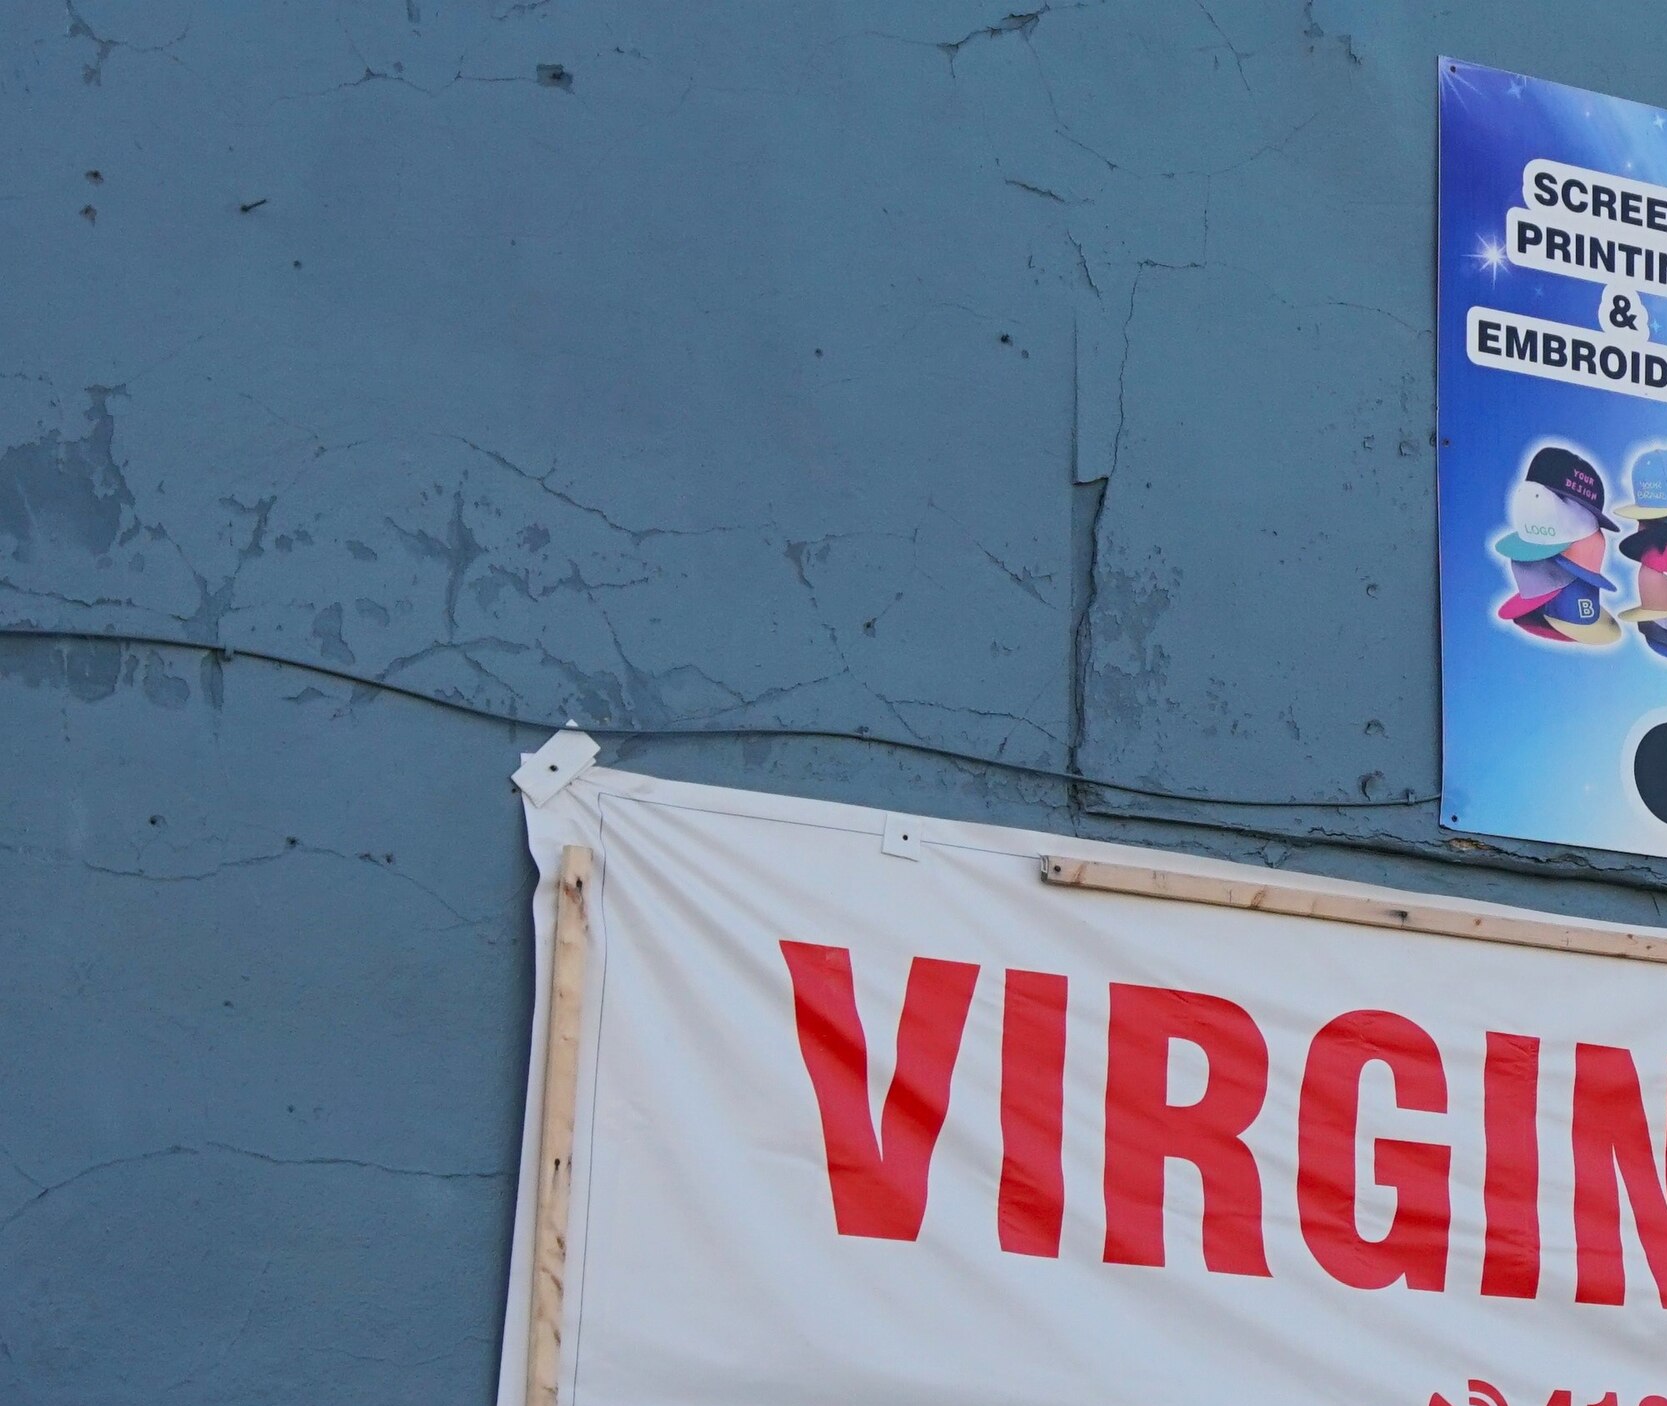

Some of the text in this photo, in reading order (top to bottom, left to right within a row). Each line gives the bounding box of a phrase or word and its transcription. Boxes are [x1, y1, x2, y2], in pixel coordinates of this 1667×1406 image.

[1608, 294, 1638, 331] &
[1573, 468, 1595, 486] YOUR
[1564, 478, 1598, 501] DESIGN
[1525, 523, 1557, 537] LOGO
[1577, 598, 1595, 619] B
